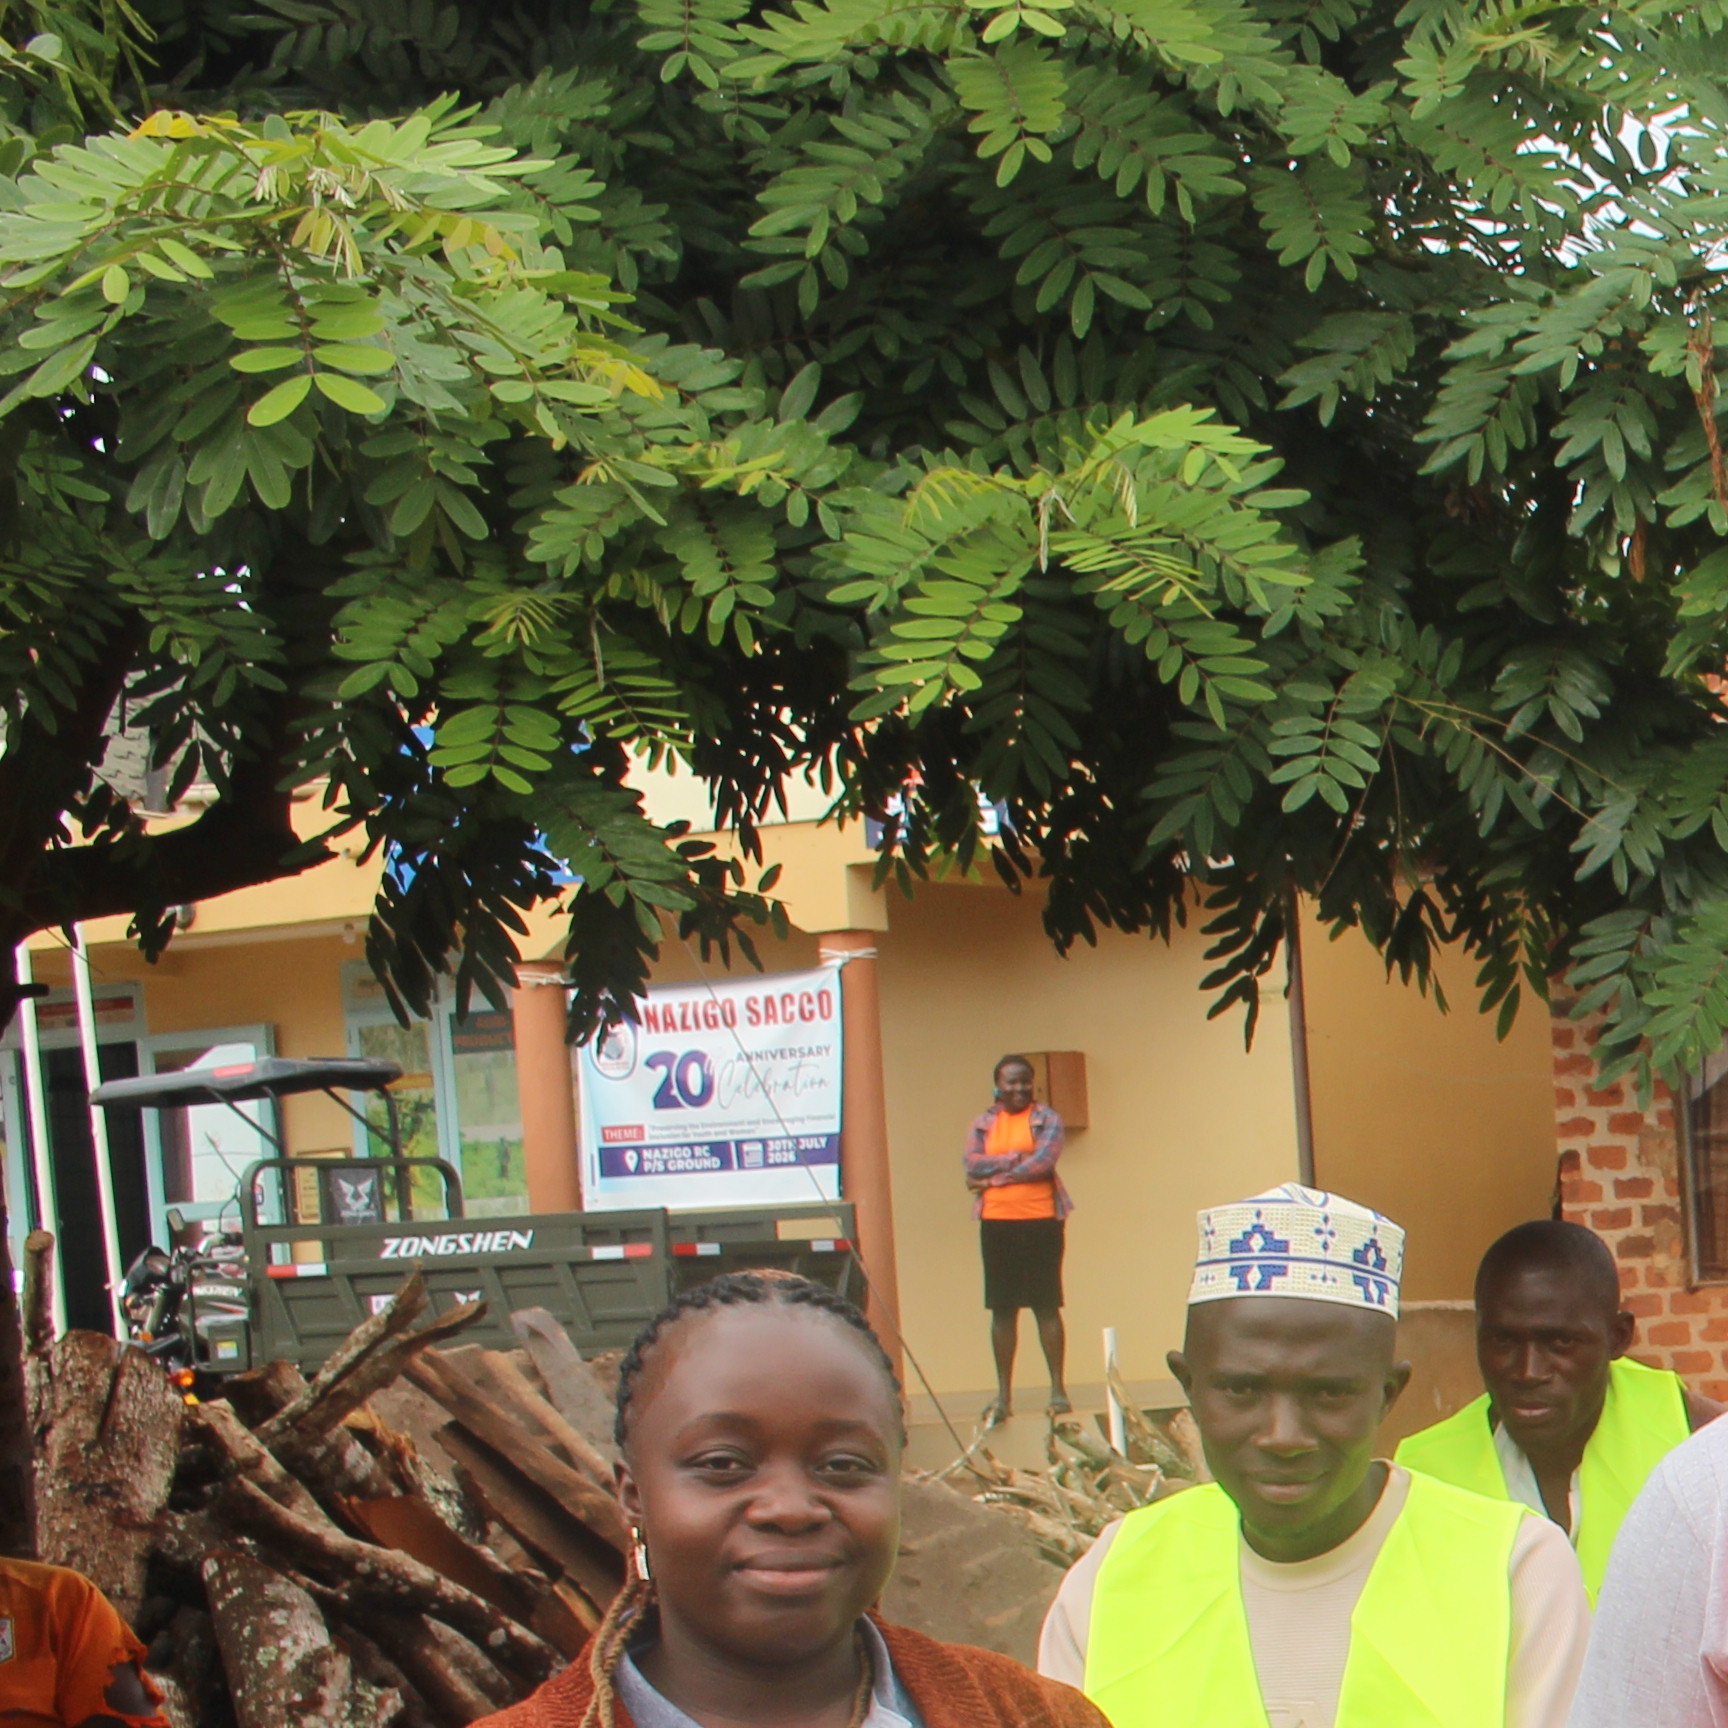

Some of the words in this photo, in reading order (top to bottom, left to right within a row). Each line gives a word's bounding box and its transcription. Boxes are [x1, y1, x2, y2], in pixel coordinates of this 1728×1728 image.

[643, 998, 738, 1035] NAZIGO
[745, 989, 833, 1028] SACCO
[736, 1044, 832, 1063] ANNIVERSARY
[718, 1059, 830, 1110] Celebration
[603, 1128, 643, 1141] THEME:
[798, 1136, 828, 1150] JULY
[643, 1147, 692, 1160] NAZIGO
[693, 1146, 711, 1158] RC
[643, 1159, 666, 1172] P/S
[667, 1156, 721, 1171] GROUND
[380, 1229, 536, 1259] ZONGSHEN
